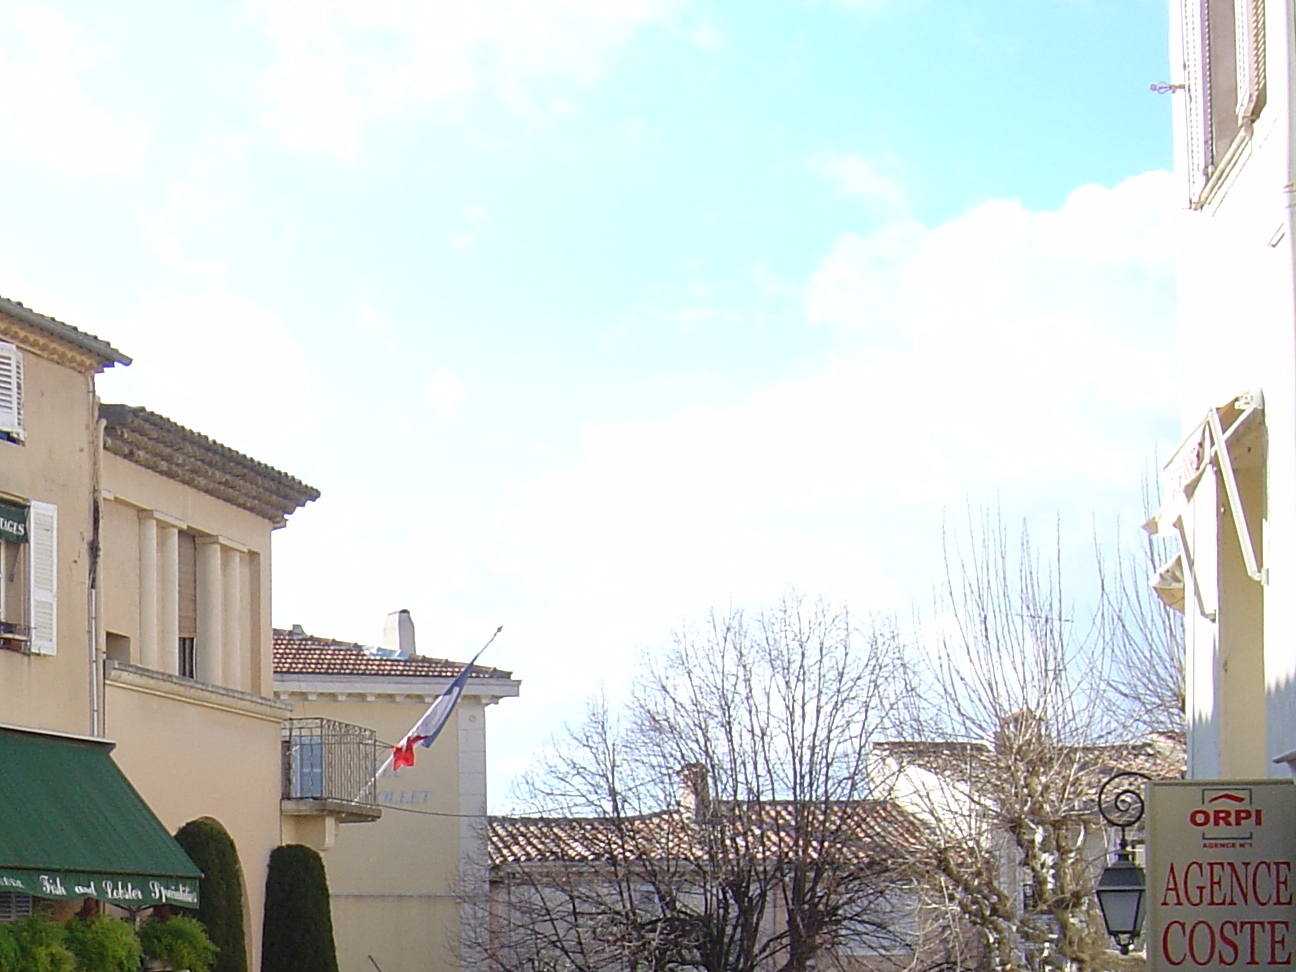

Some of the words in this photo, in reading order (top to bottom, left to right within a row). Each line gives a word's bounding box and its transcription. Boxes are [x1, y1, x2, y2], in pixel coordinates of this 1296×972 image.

[373, 790, 432, 804] OLLET
[1189, 809, 1263, 827] ORPI
[40, 874, 67, 896] Fish
[74, 881, 97, 896] and
[1161, 861, 1293, 907] AGENCE
[1162, 920, 1292, 967] COSTE
